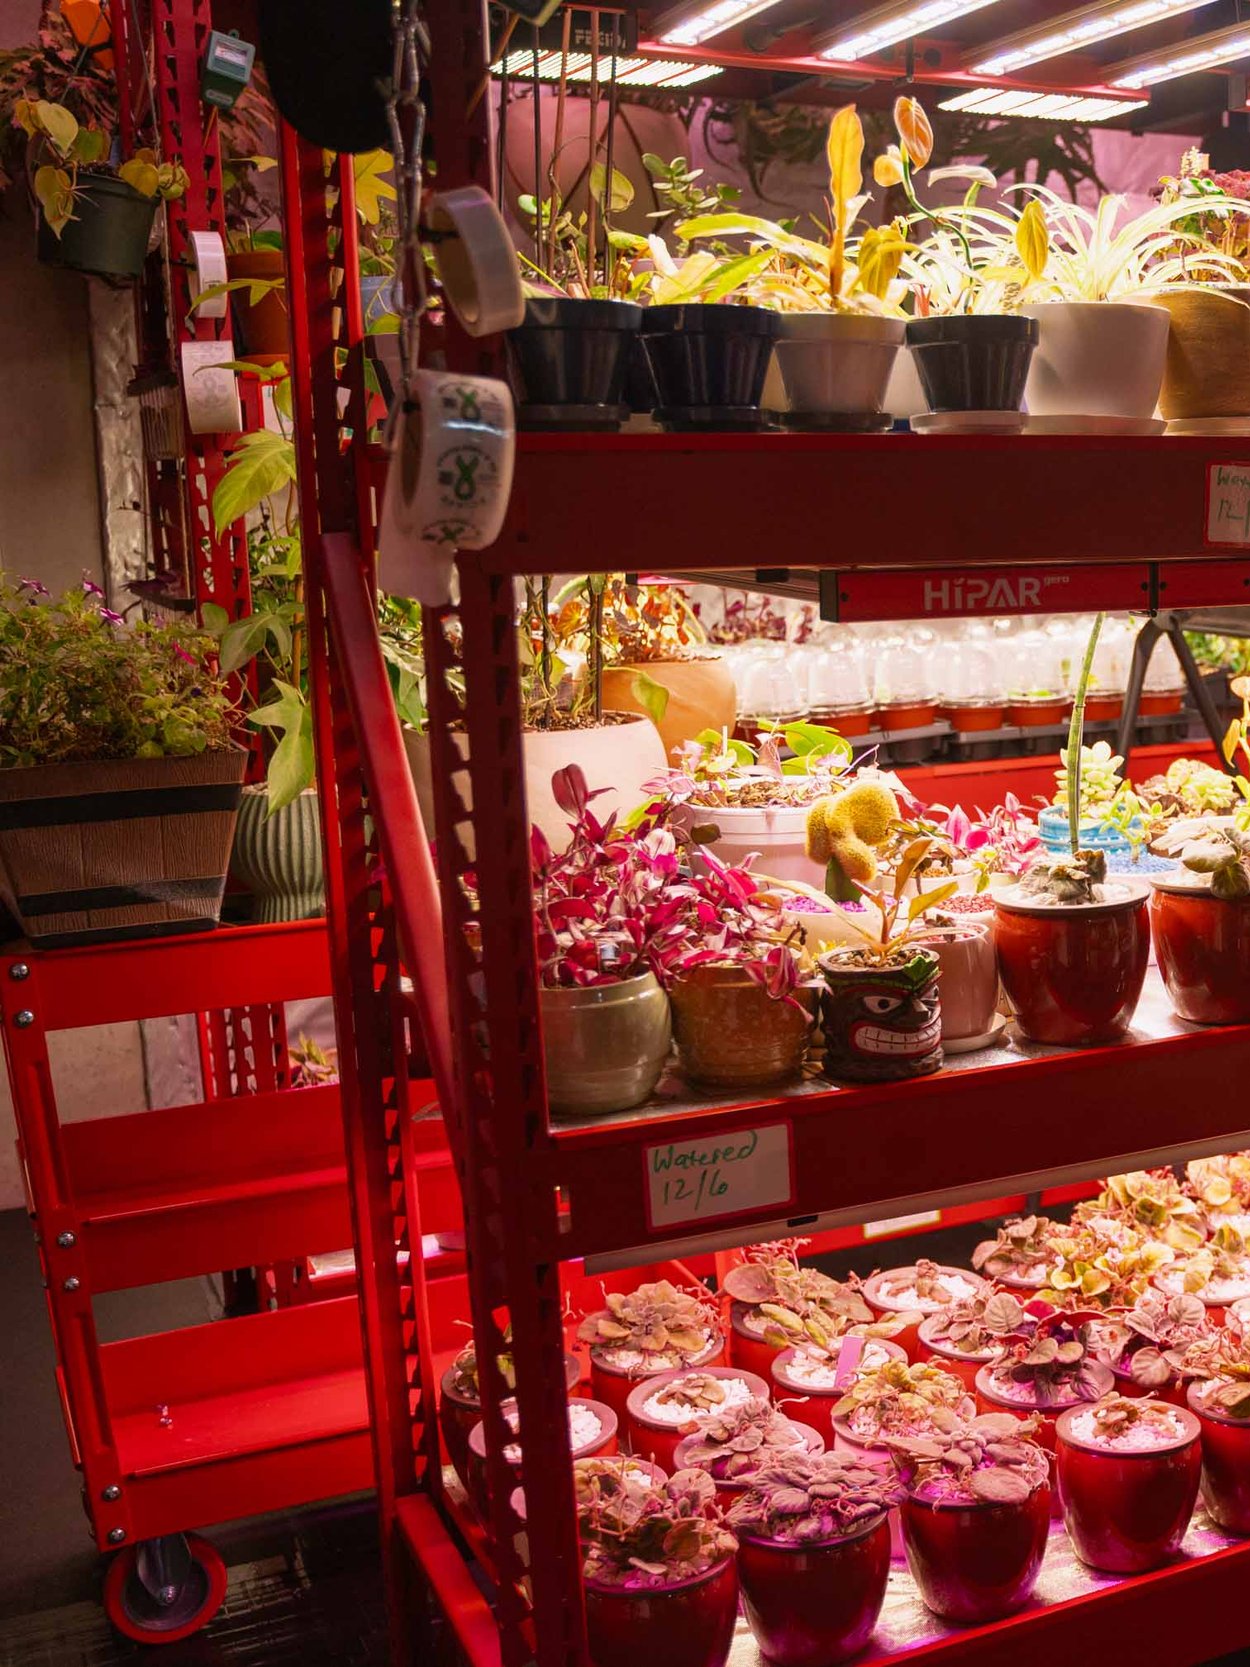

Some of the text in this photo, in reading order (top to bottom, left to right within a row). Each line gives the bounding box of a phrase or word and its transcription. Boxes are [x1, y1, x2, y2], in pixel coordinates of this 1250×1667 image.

[923, 576, 1041, 611] HiPAR
[653, 1129, 758, 1172] Watered
[663, 1169, 728, 1211] 12/6
